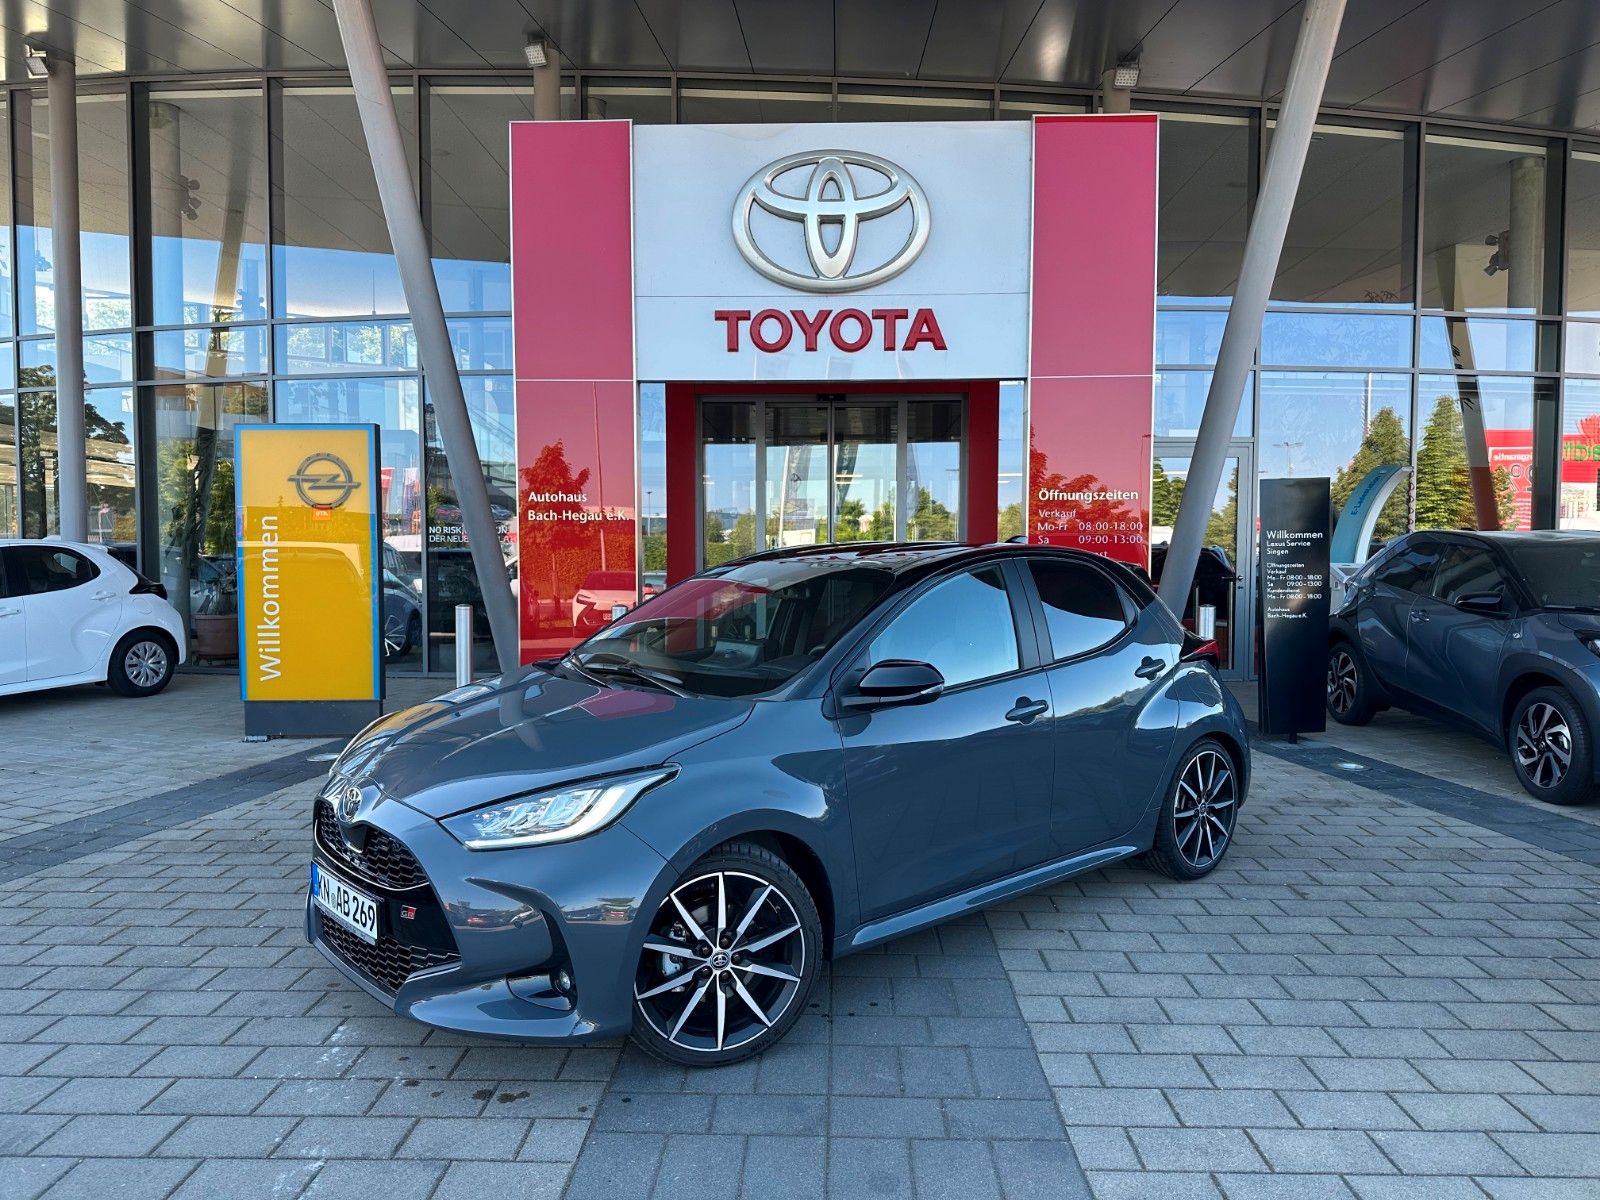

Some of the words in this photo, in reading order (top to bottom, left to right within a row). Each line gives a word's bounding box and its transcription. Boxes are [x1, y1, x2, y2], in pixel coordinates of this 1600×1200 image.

[715, 308, 948, 353] TOYOTA
[528, 490, 588, 502] Autohaus
[1038, 487, 1139, 503] Öffnungszeiten
[528, 509, 602, 523] Bach-Hegau
[606, 510, 629, 521] e.K.
[1038, 508, 1077, 518] Verkauf
[429, 526, 442, 534] NO
[1037, 521, 1068, 531] Mo-Fr
[1078, 521, 1143, 531] 08:00-18:00
[1037, 535, 1050, 545] Sa
[1078, 534, 1143, 544] 09:00-13:00
[1266, 529, 1323, 539] Willkommen
[1266, 548, 1289, 556] Singen
[256, 515, 282, 682] Willkommen
[318, 871, 330, 904] KN
[336, 885, 351, 918] AB
[352, 895, 376, 932] 269
